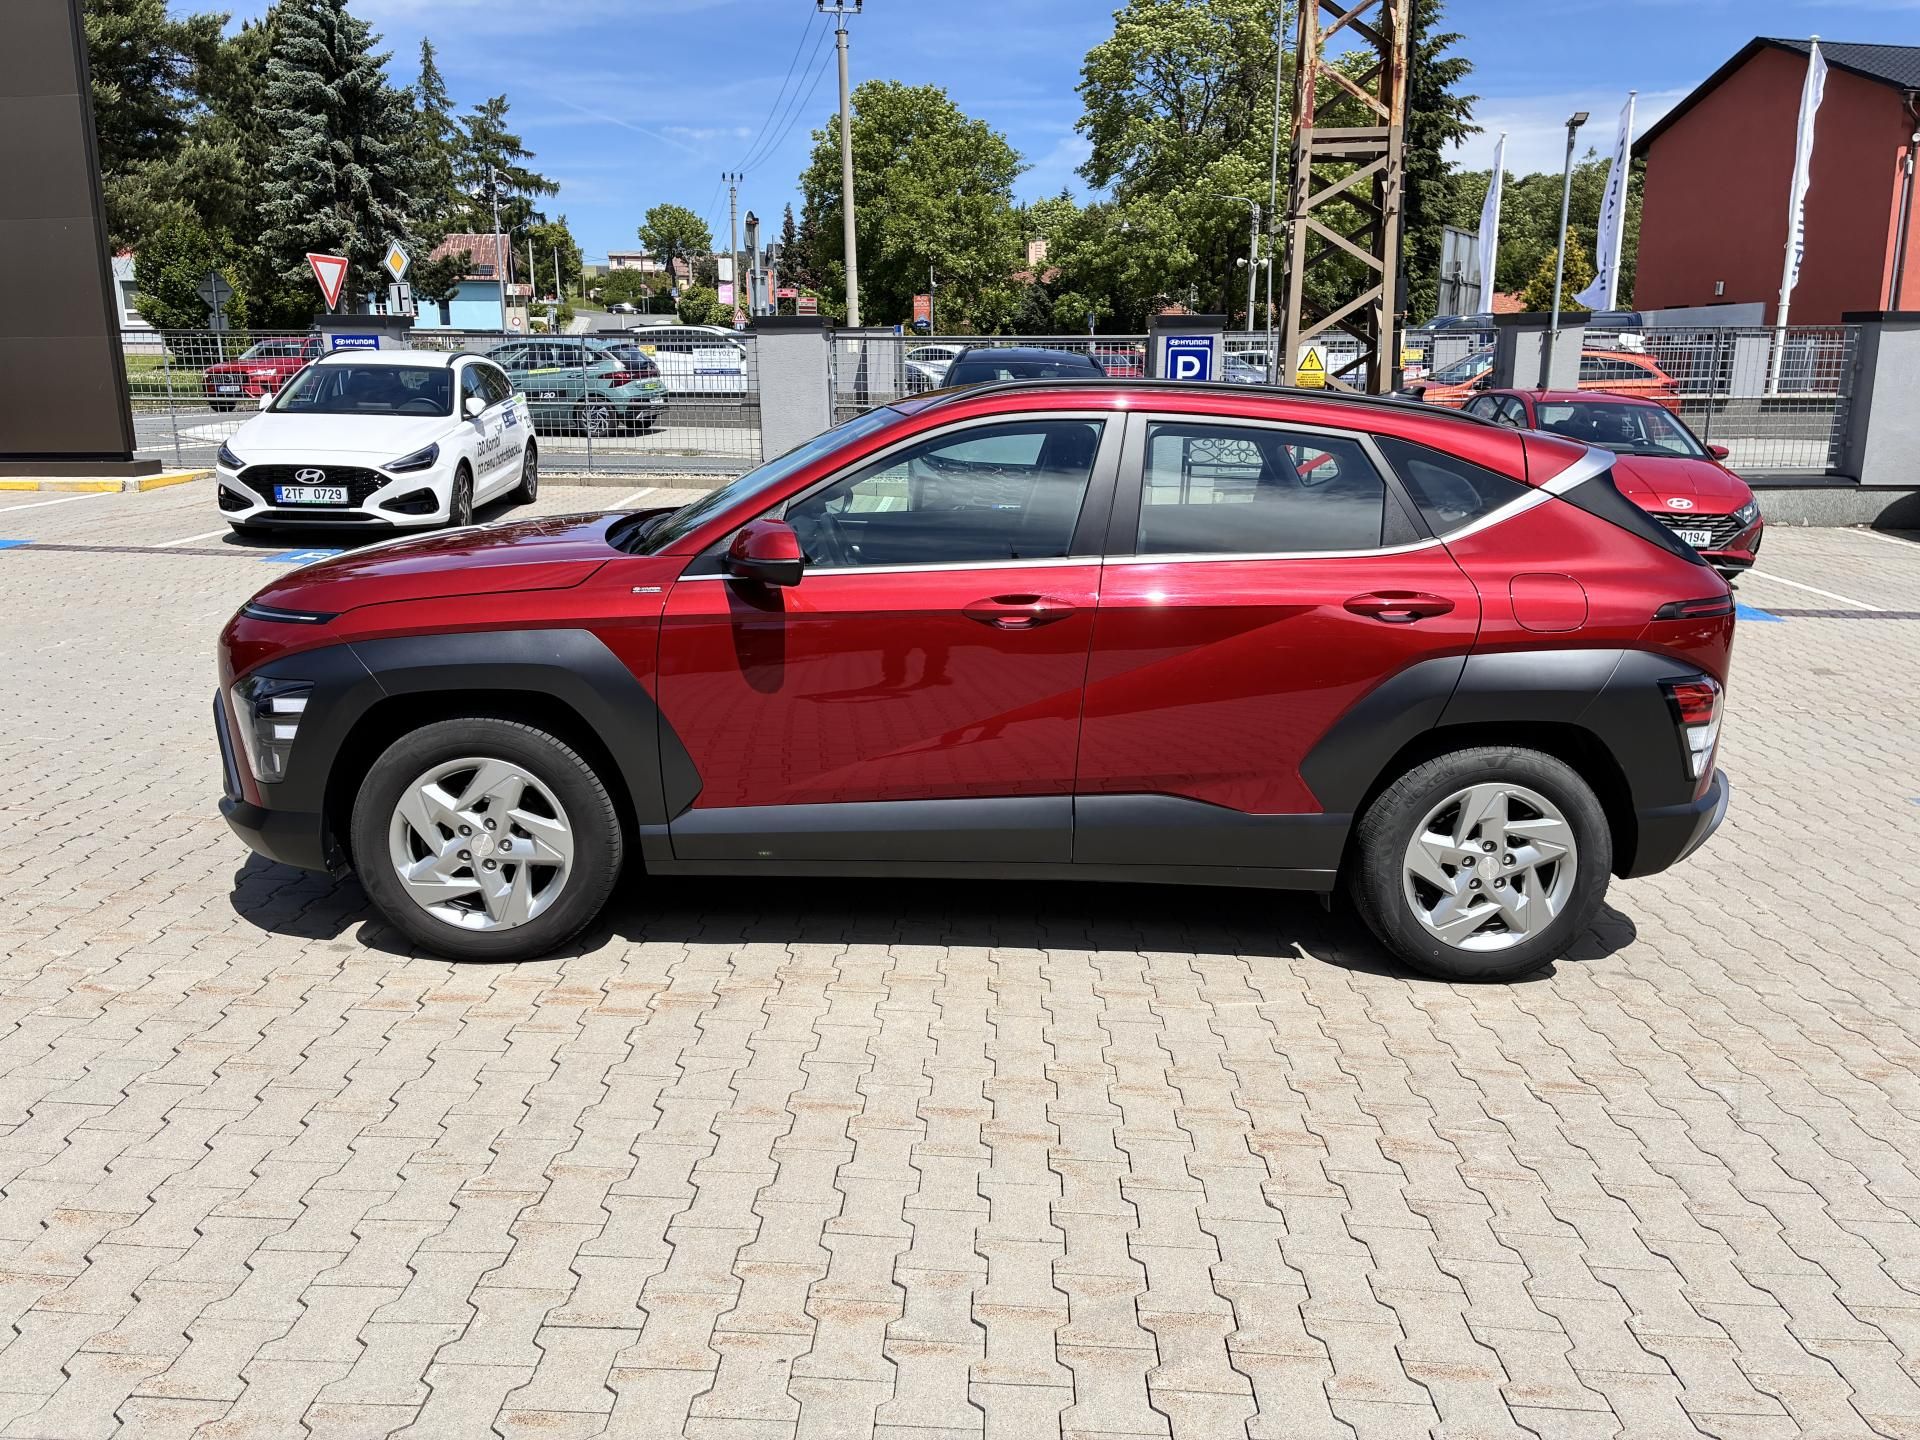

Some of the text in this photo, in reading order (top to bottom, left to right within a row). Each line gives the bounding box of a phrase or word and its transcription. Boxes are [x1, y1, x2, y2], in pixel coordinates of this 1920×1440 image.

[1176, 355, 1201, 380] P
[284, 487, 342, 500] 2TF 0729
[1680, 531, 1706, 543] 0194
